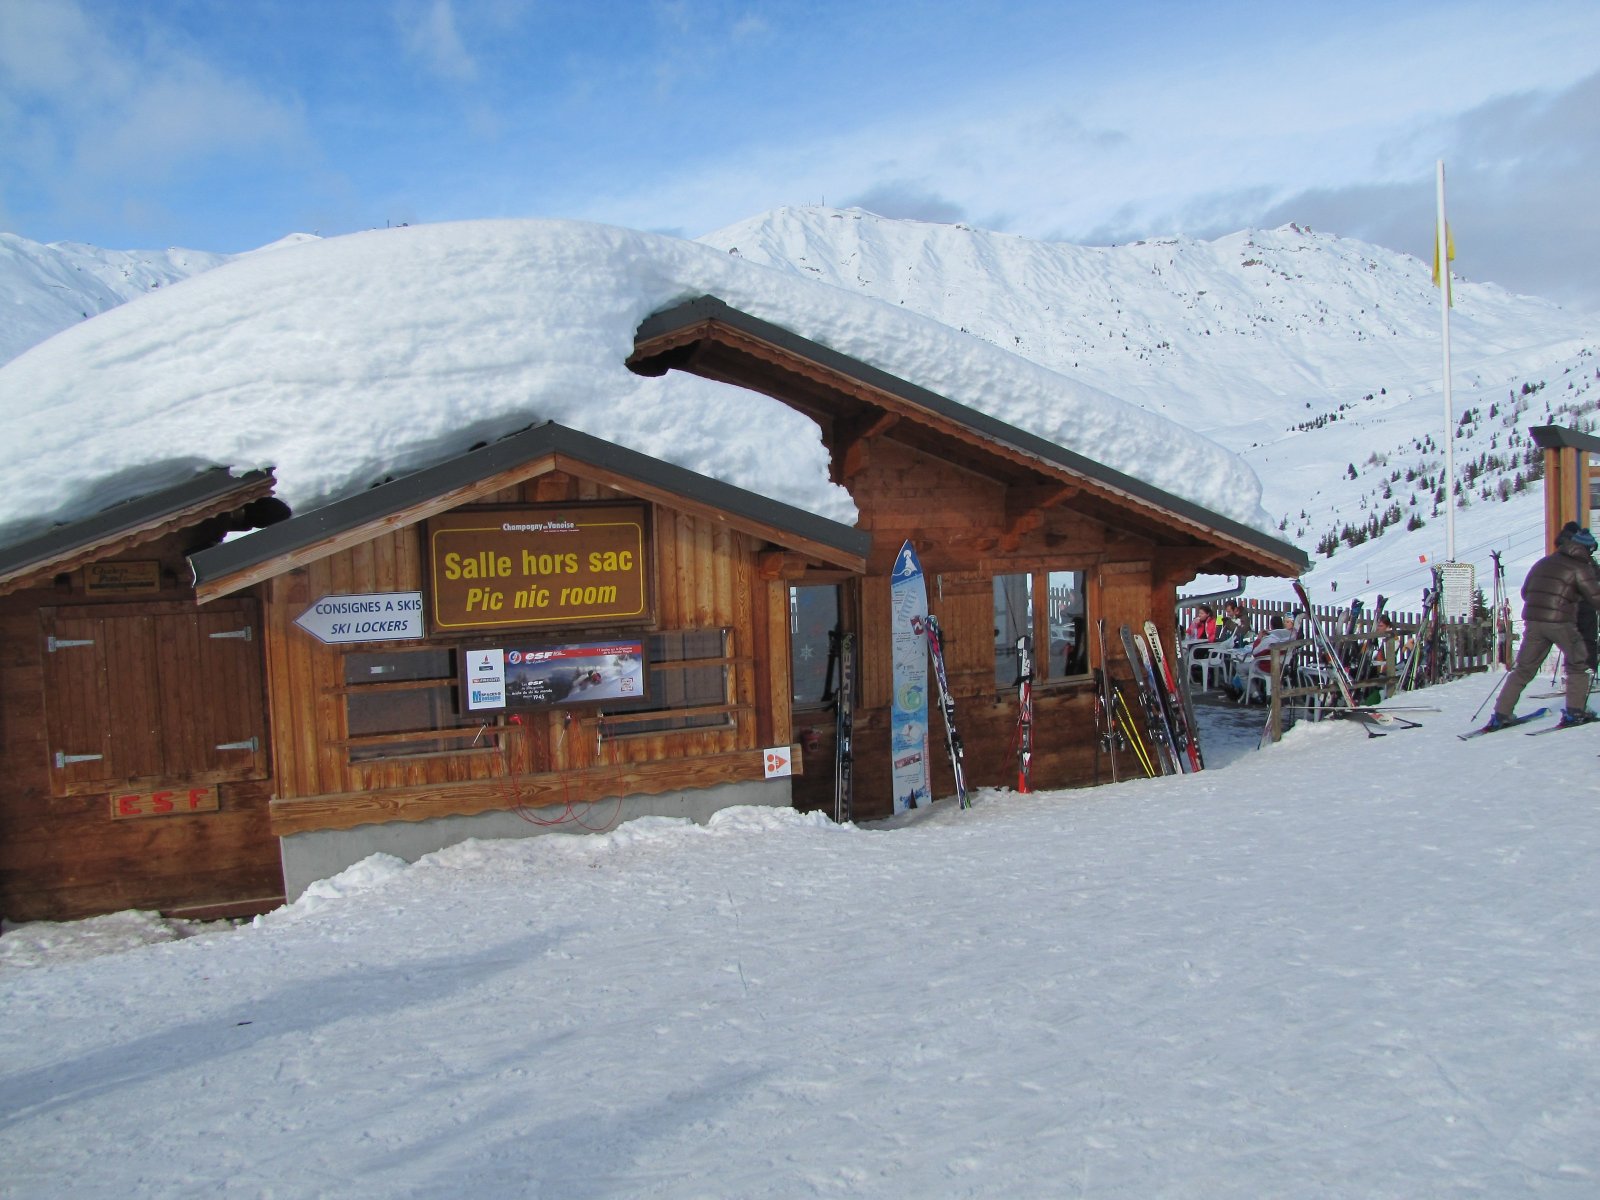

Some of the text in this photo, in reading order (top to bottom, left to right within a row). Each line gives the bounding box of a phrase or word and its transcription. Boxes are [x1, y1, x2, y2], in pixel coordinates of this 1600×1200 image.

[502, 522, 543, 532] Champagny
[548, 521, 575, 530] Vanoise
[445, 550, 633, 580] Salle hors sac
[315, 600, 422, 615] CONSIGNES A SKIS
[466, 586, 617, 612] Pic nic room
[331, 621, 408, 635] SKI LOCKERS
[118, 789, 209, 816] ESF
